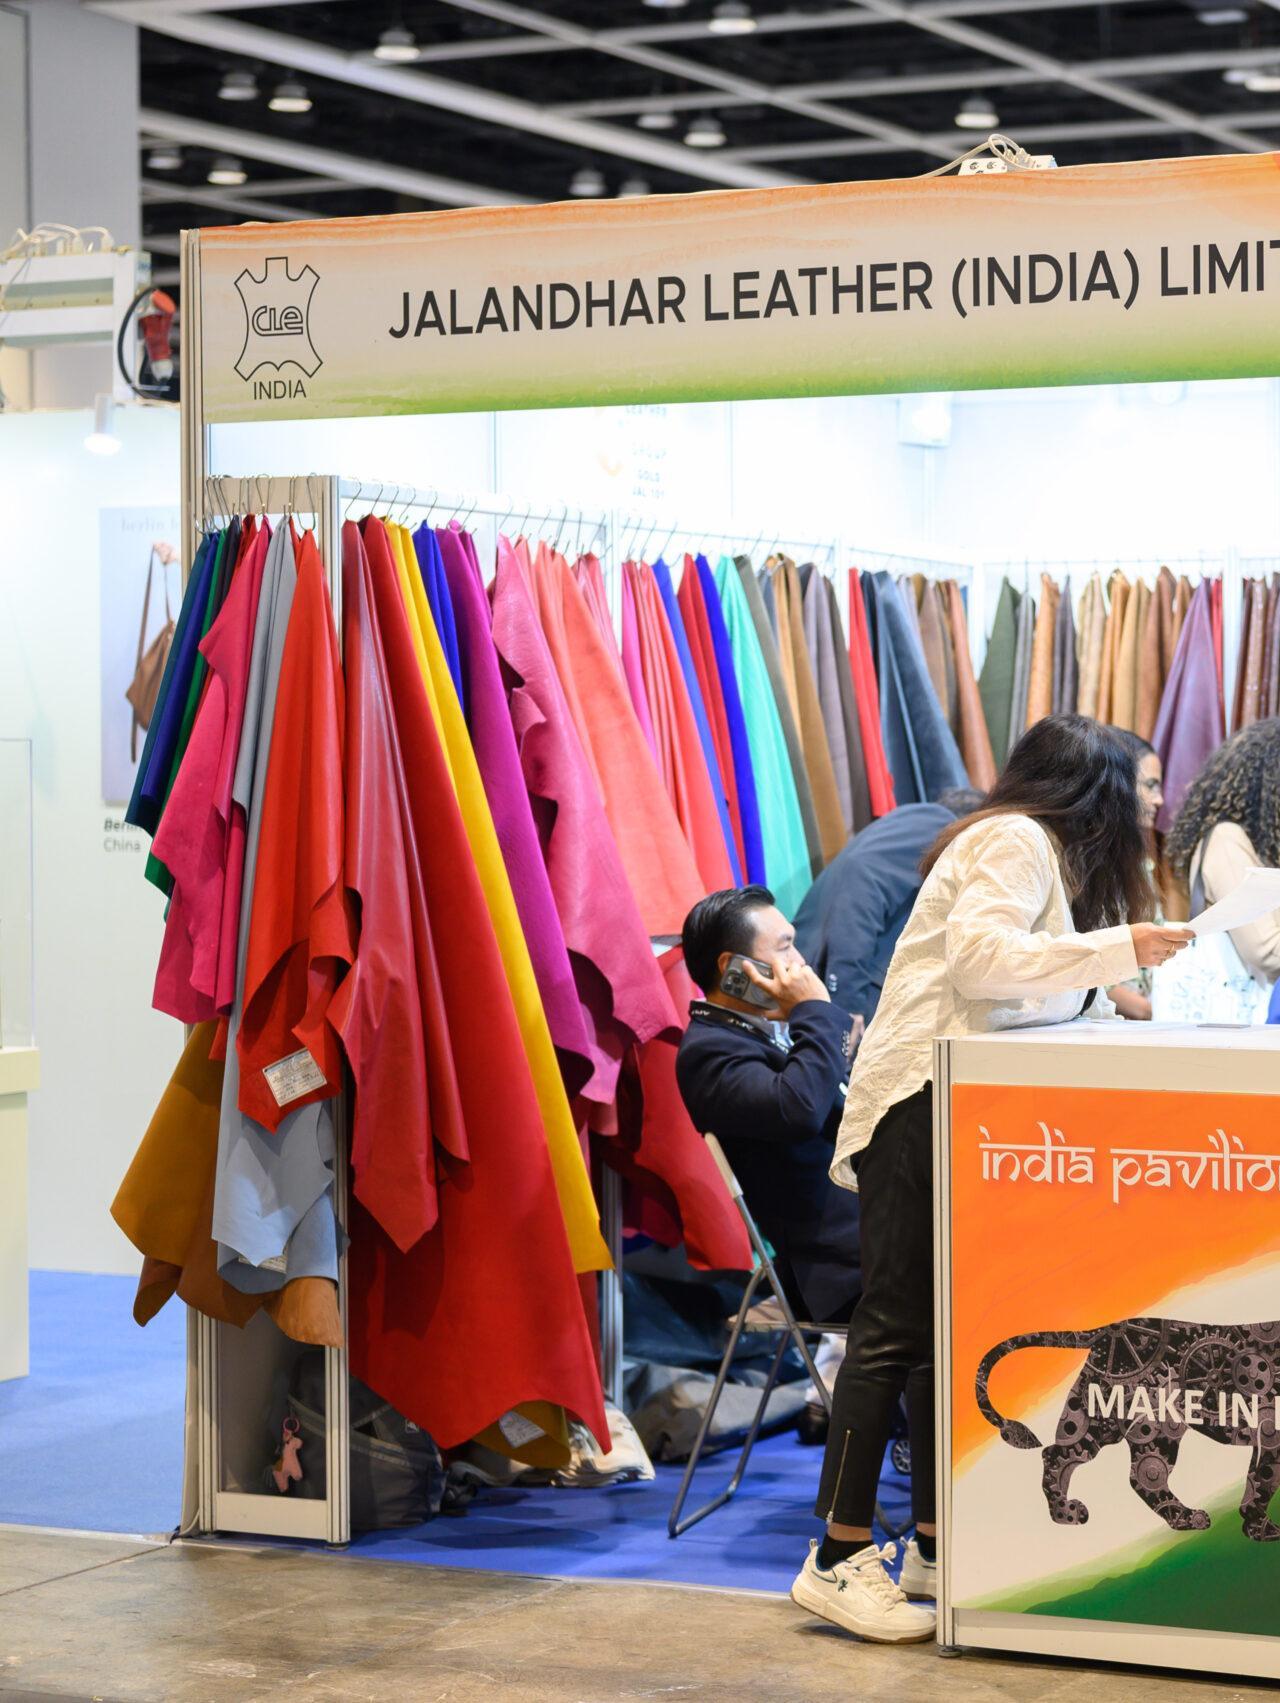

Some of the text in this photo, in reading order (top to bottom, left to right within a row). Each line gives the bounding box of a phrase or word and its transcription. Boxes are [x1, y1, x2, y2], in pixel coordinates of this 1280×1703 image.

[389, 275, 686, 339] JALANDHAR
[704, 260, 933, 322] LEATHER
[952, 247, 1139, 319] (INDIA)
[254, 380, 307, 400] INDIA
[104, 838, 141, 853] China
[979, 1122, 1095, 1184] india
[1088, 1383, 1203, 1424] MAKE
[1218, 1391, 1259, 1429] IN
